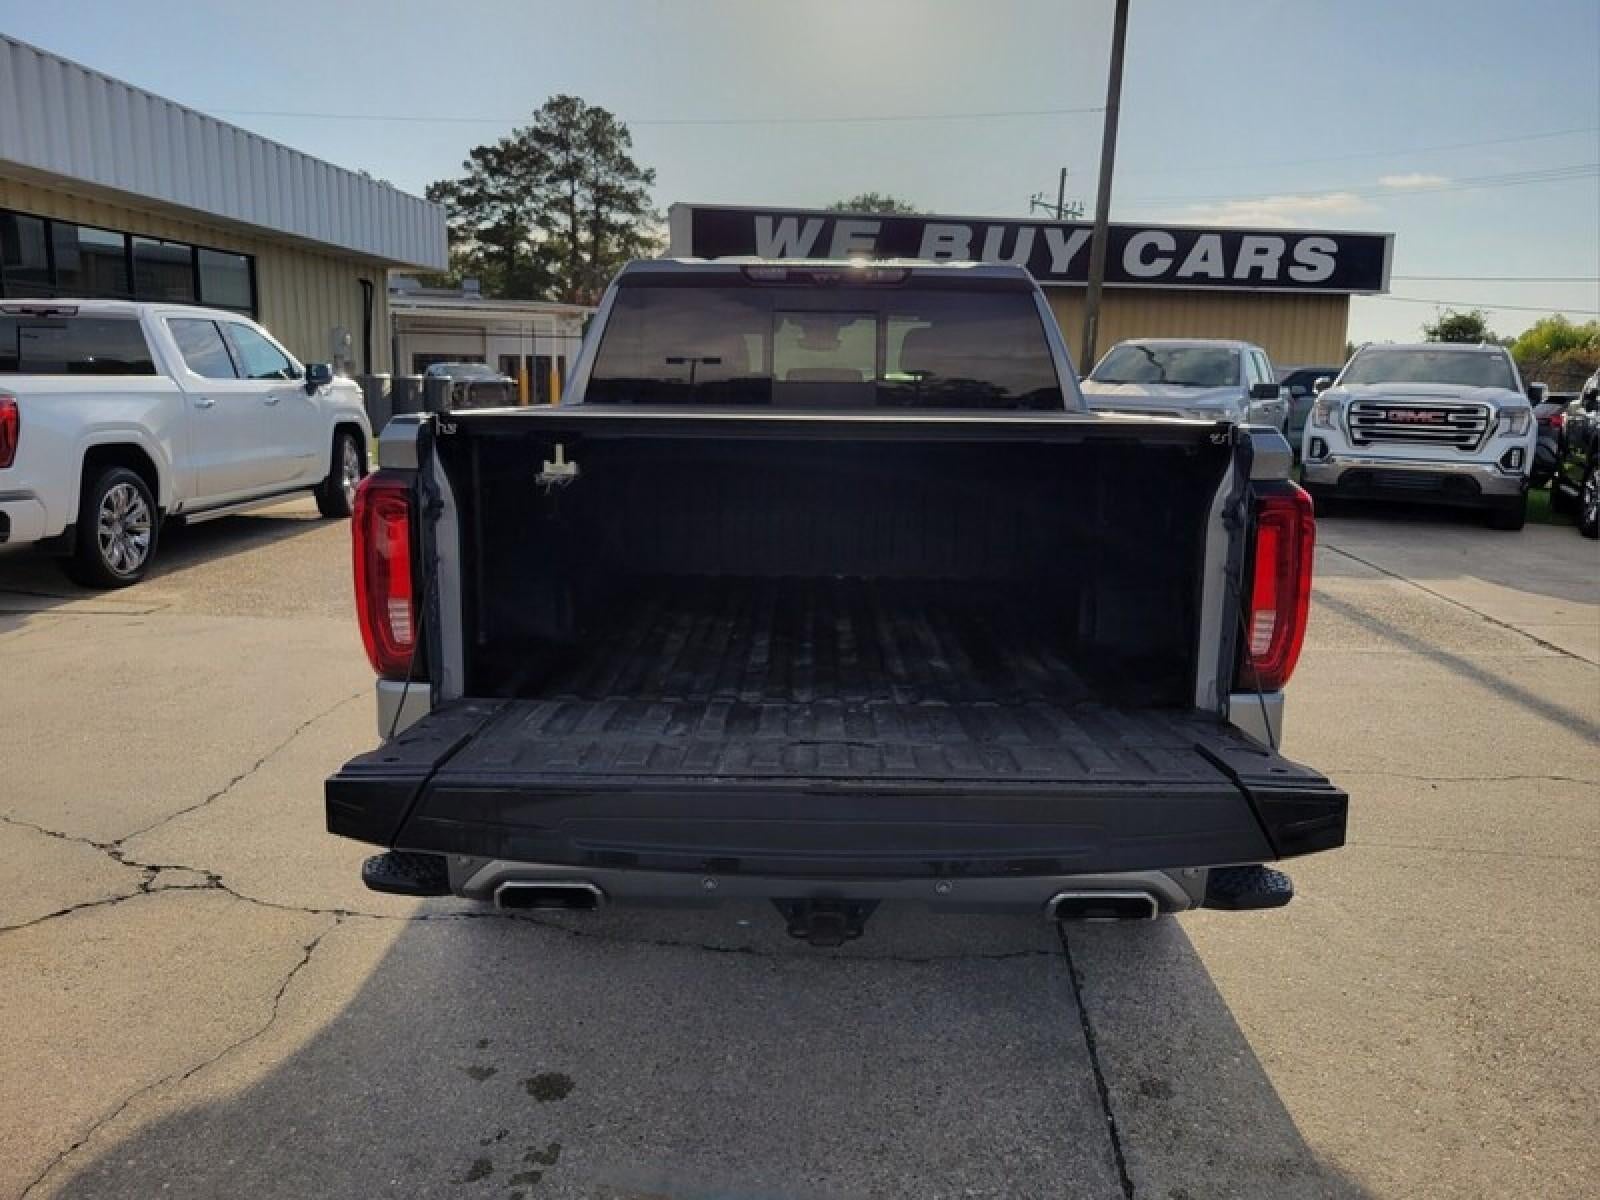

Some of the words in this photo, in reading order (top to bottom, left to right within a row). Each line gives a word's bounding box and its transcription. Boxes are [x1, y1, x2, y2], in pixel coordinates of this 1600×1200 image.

[755, 215, 881, 259] WE
[918, 223, 1092, 273] BUY
[1122, 230, 1339, 283] CARS
[1387, 410, 1445, 423] GMC
